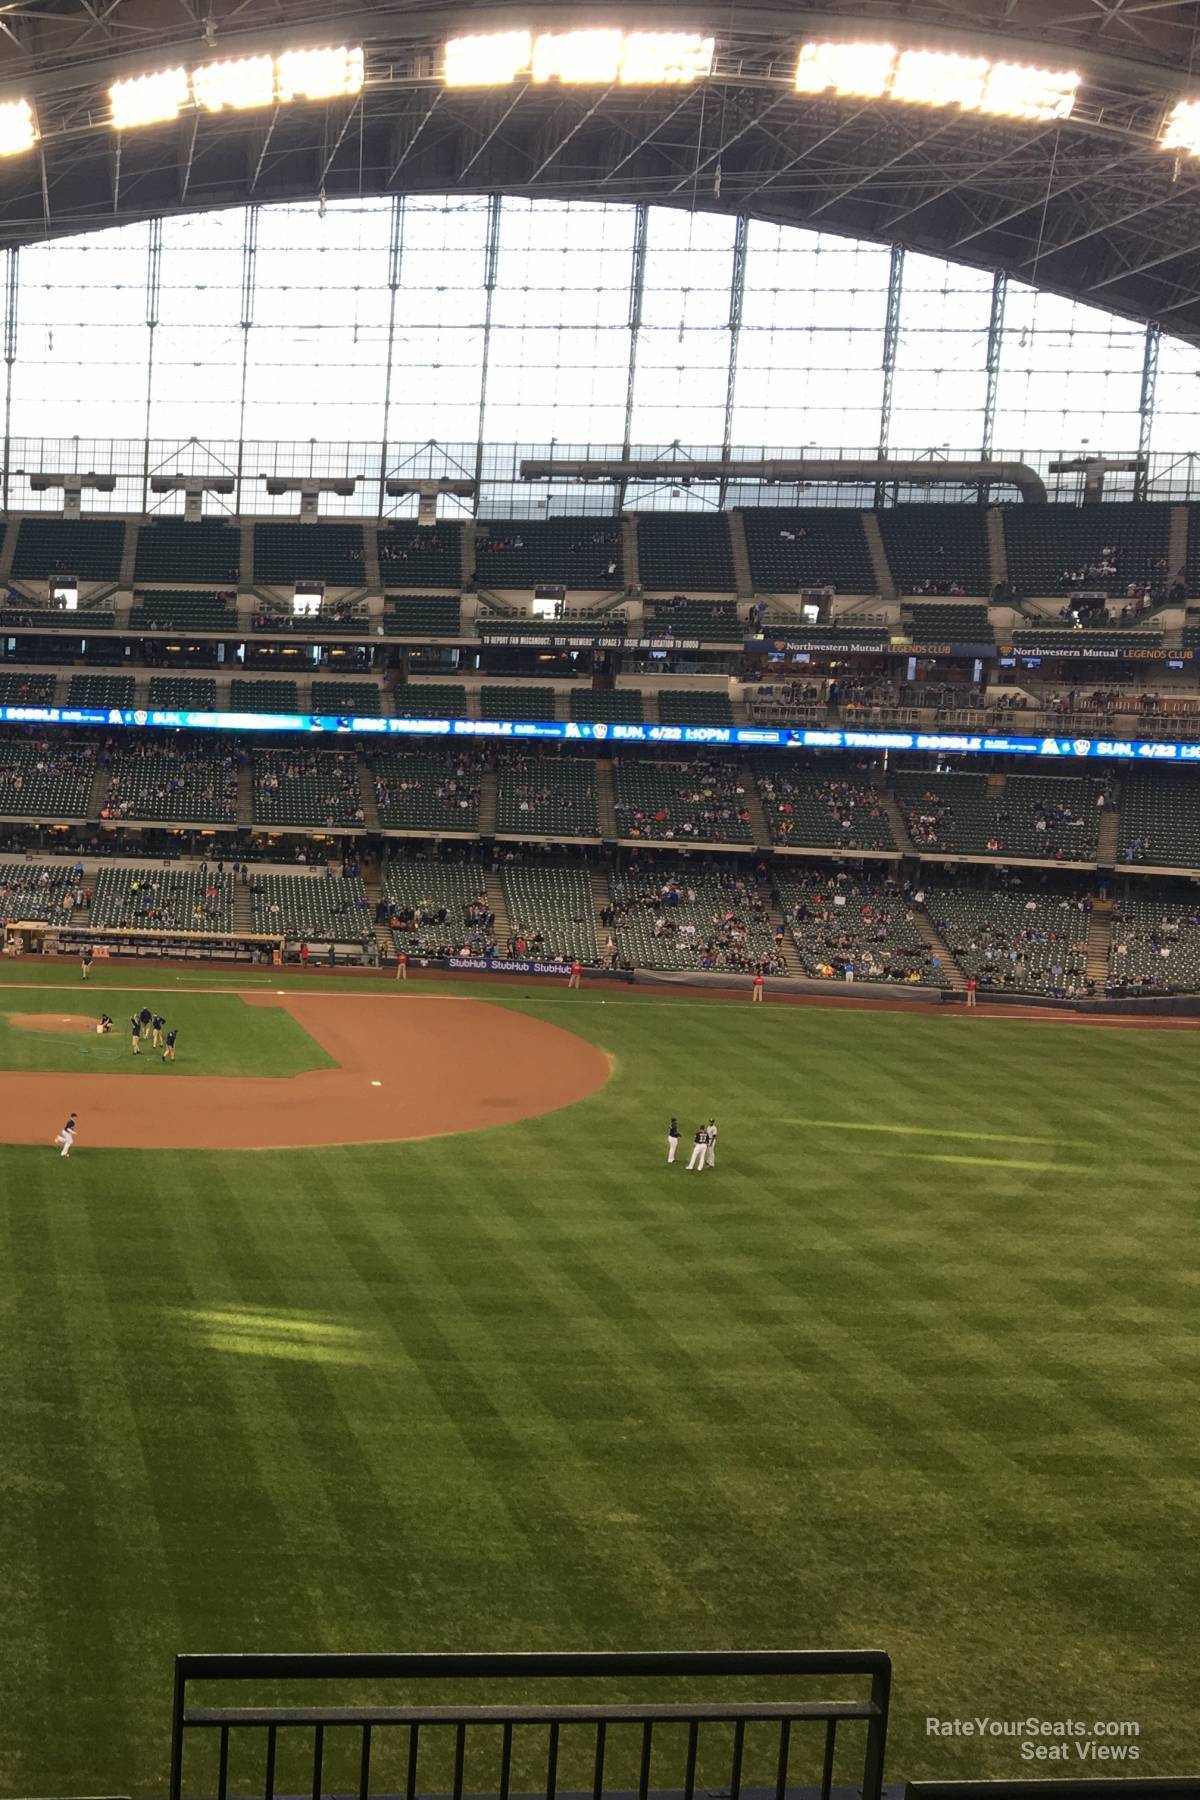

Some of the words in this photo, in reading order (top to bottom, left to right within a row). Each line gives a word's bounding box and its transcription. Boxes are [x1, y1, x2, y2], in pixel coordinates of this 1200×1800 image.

[554, 638, 566, 646] TEXT
[640, 639, 650, 648] AND
[651, 640, 674, 648] LOCATION
[786, 642, 848, 652] Northwestern
[850, 643, 883, 652] Mutual
[887, 644, 927, 654] LEGENDS
[928, 645, 951, 654] CLUB
[1013, 647, 1080, 657] Northwestern
[1082, 649, 1119, 658] Mutual
[1123, 650, 1167, 659] LEGENDS
[1168, 651, 1194, 659] CLUB
[613, 726, 646, 740] SUN,
[1097, 742, 1134, 757] SUN,
[1139, 744, 1176, 758] 4/22
[449, 958, 487, 969] StubHub
[491, 960, 530, 972] StubHub
[533, 963, 571, 974] StubHub
